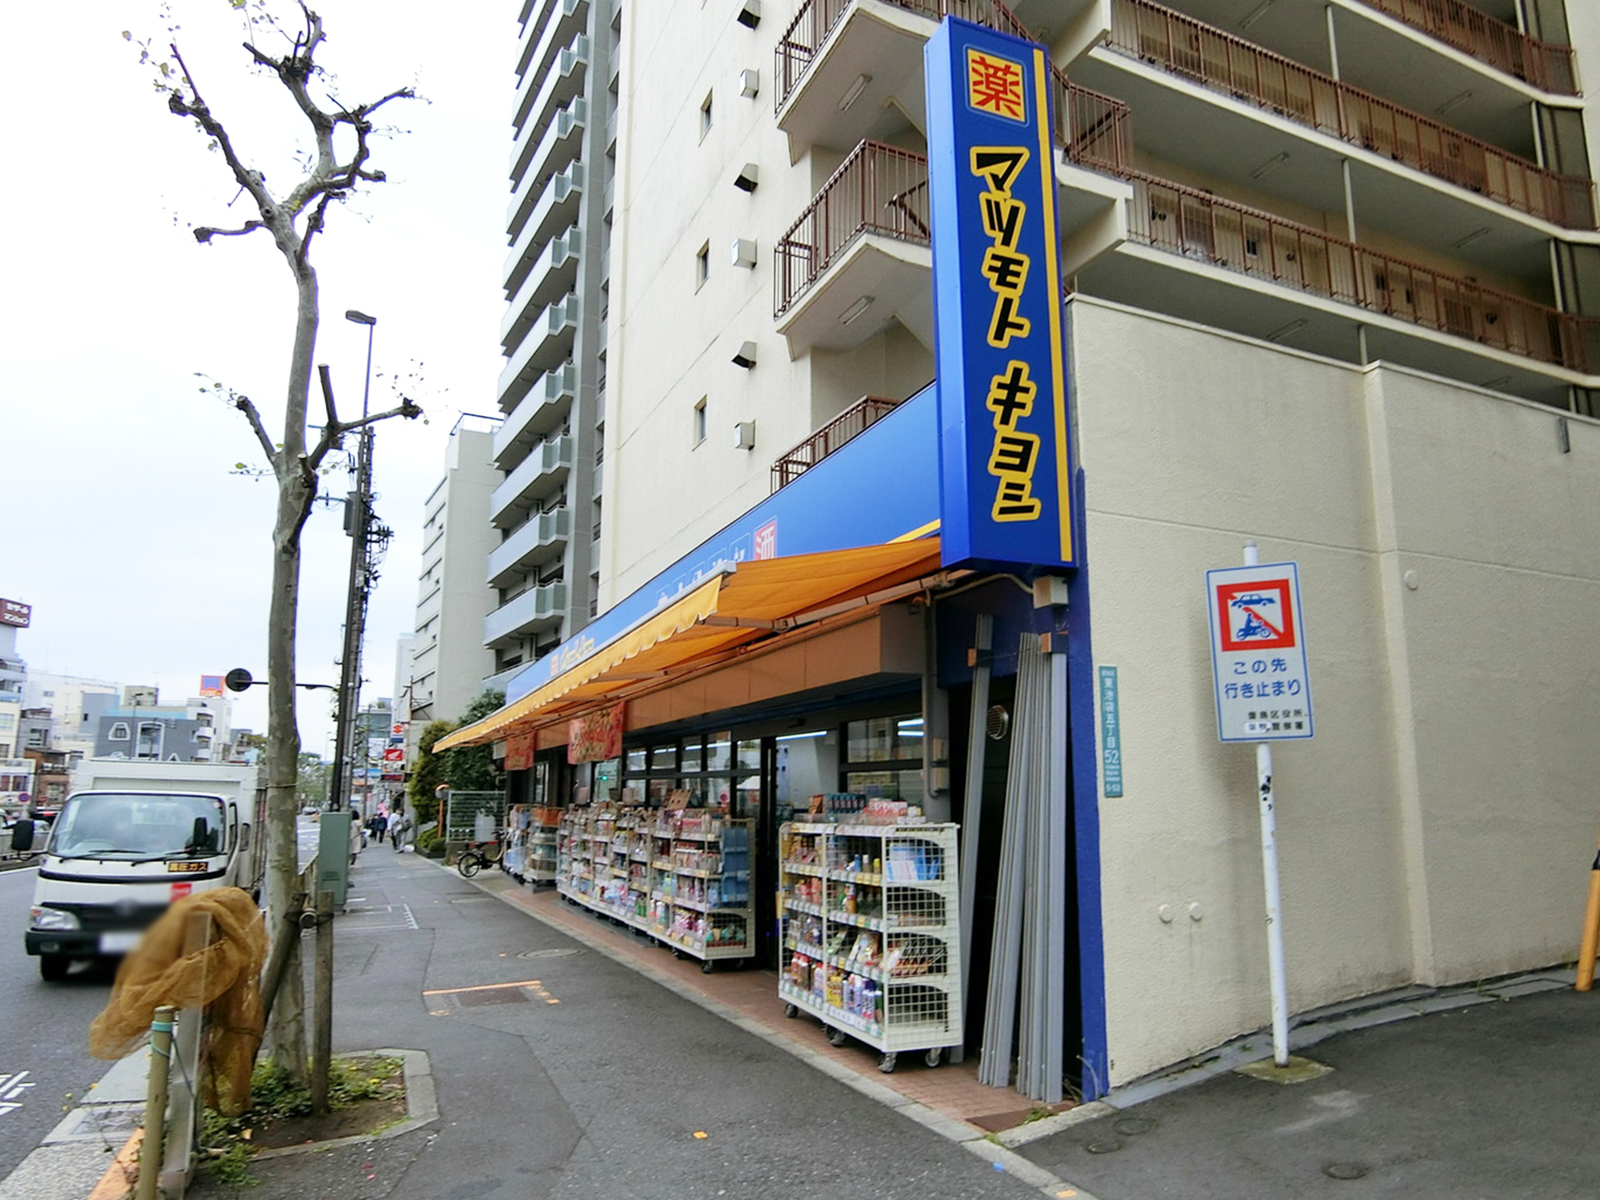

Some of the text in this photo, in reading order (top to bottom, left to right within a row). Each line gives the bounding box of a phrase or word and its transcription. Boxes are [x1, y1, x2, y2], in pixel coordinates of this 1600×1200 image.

[971, 55, 1021, 118] 薬
[969, 146, 1042, 523] マツモトキヨシ
[1233, 658, 1287, 675] この先
[1224, 679, 1301, 699] 行き止まり
